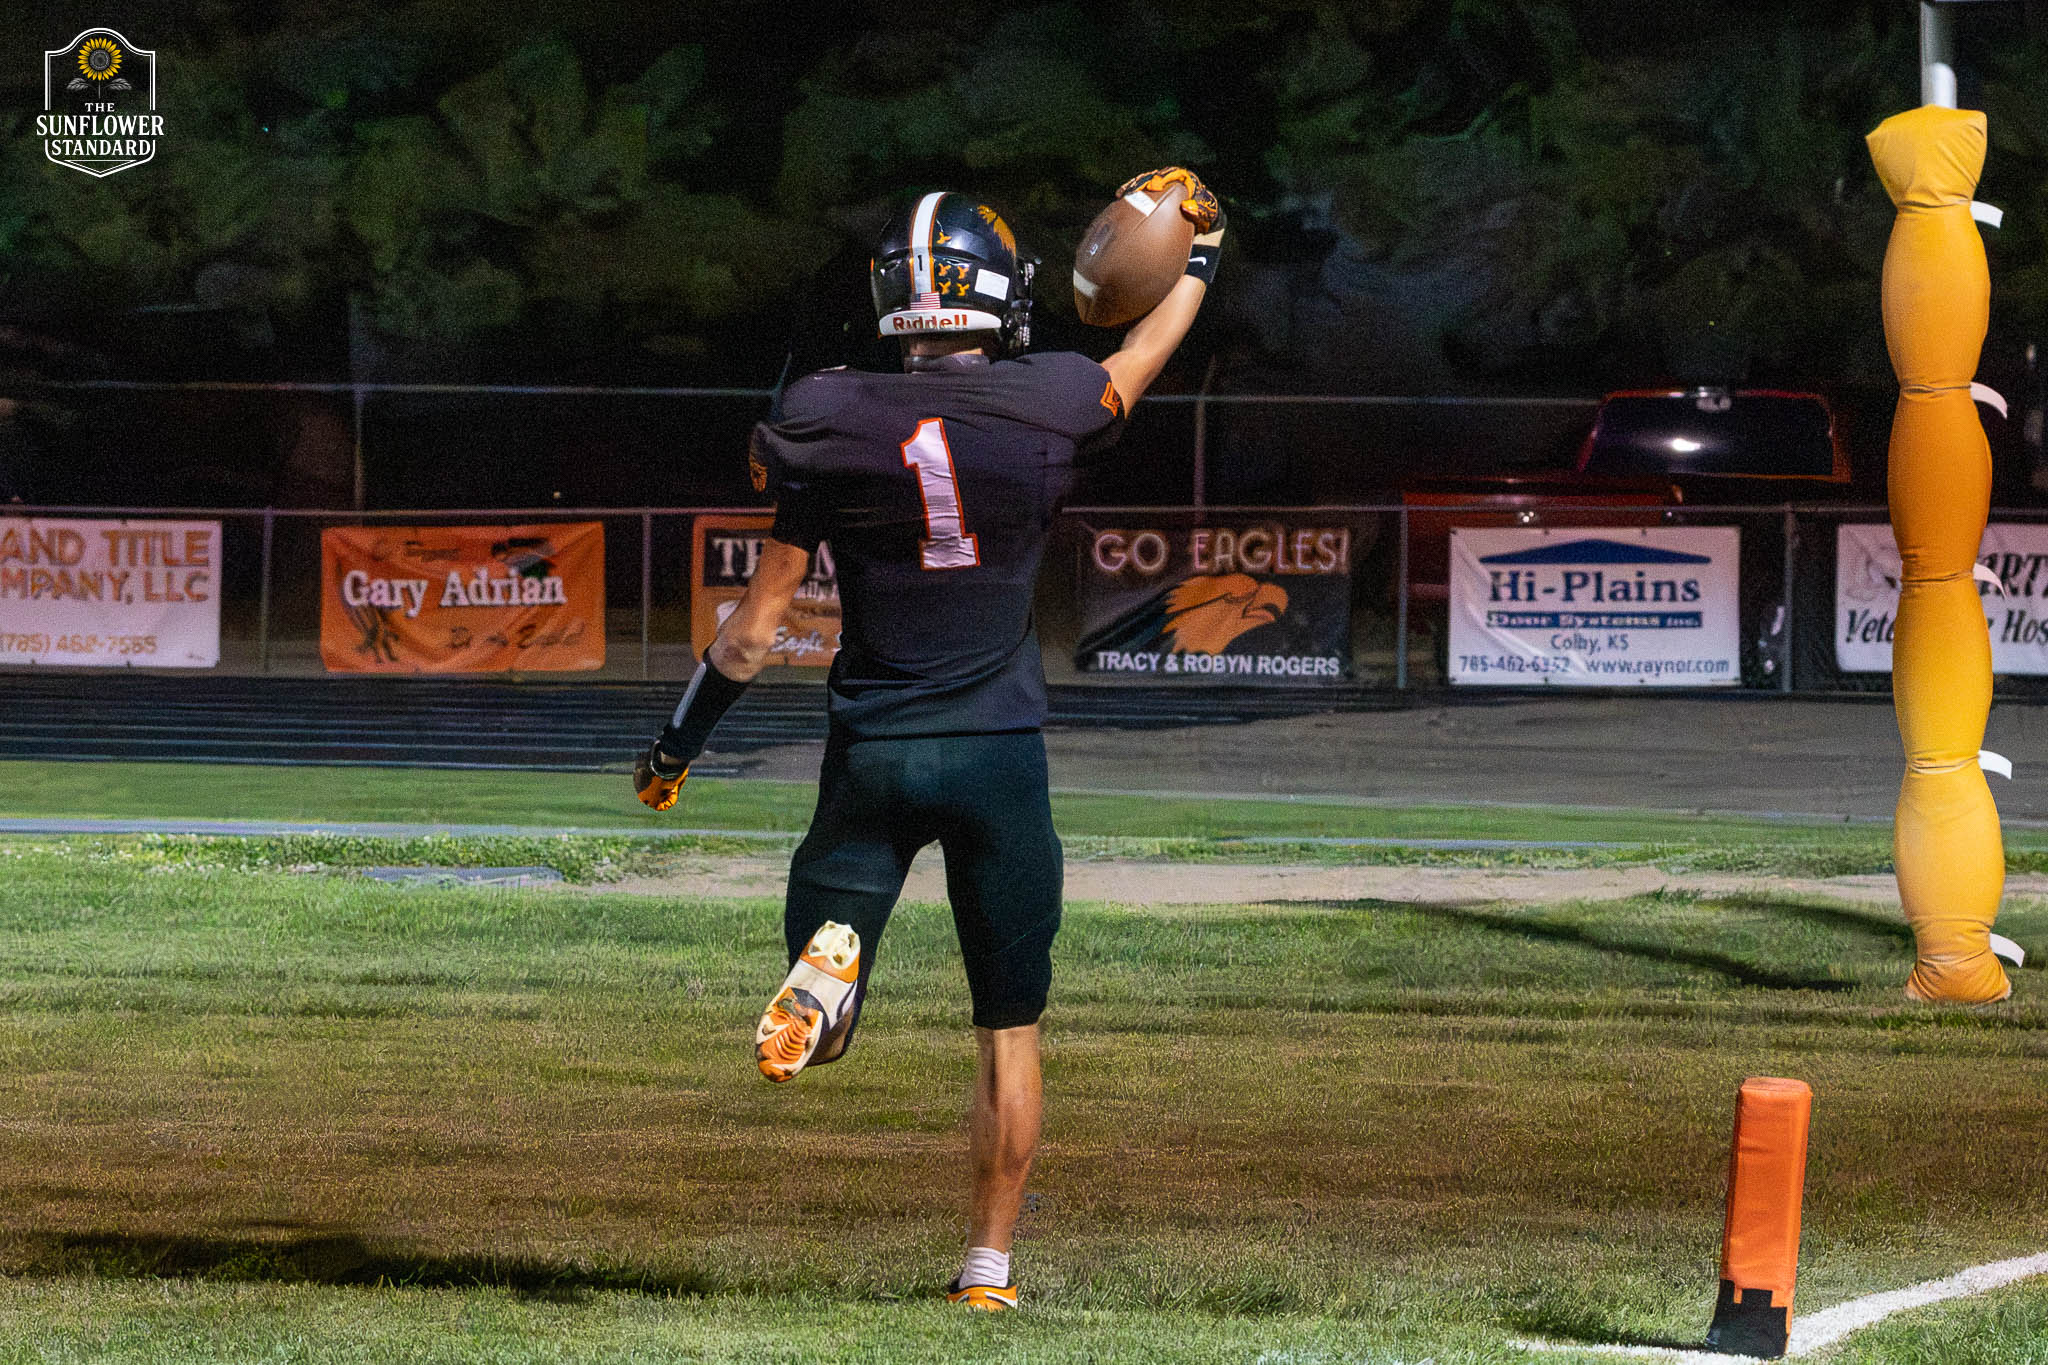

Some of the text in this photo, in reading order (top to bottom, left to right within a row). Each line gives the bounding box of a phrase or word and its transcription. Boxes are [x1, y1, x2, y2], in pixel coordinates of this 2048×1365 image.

[917, 254, 923, 271] 1
[892, 314, 968, 331] Riddell
[901, 417, 981, 571] 1
[102, 529, 212, 567] TITLE
[1094, 527, 1348, 573] GO EAGLES!
[343, 566, 567, 618] Gary Adrian
[1489, 570, 1701, 602] Hi-Plains
[1097, 651, 1340, 676] TRACY & ROBYN ROGERS
